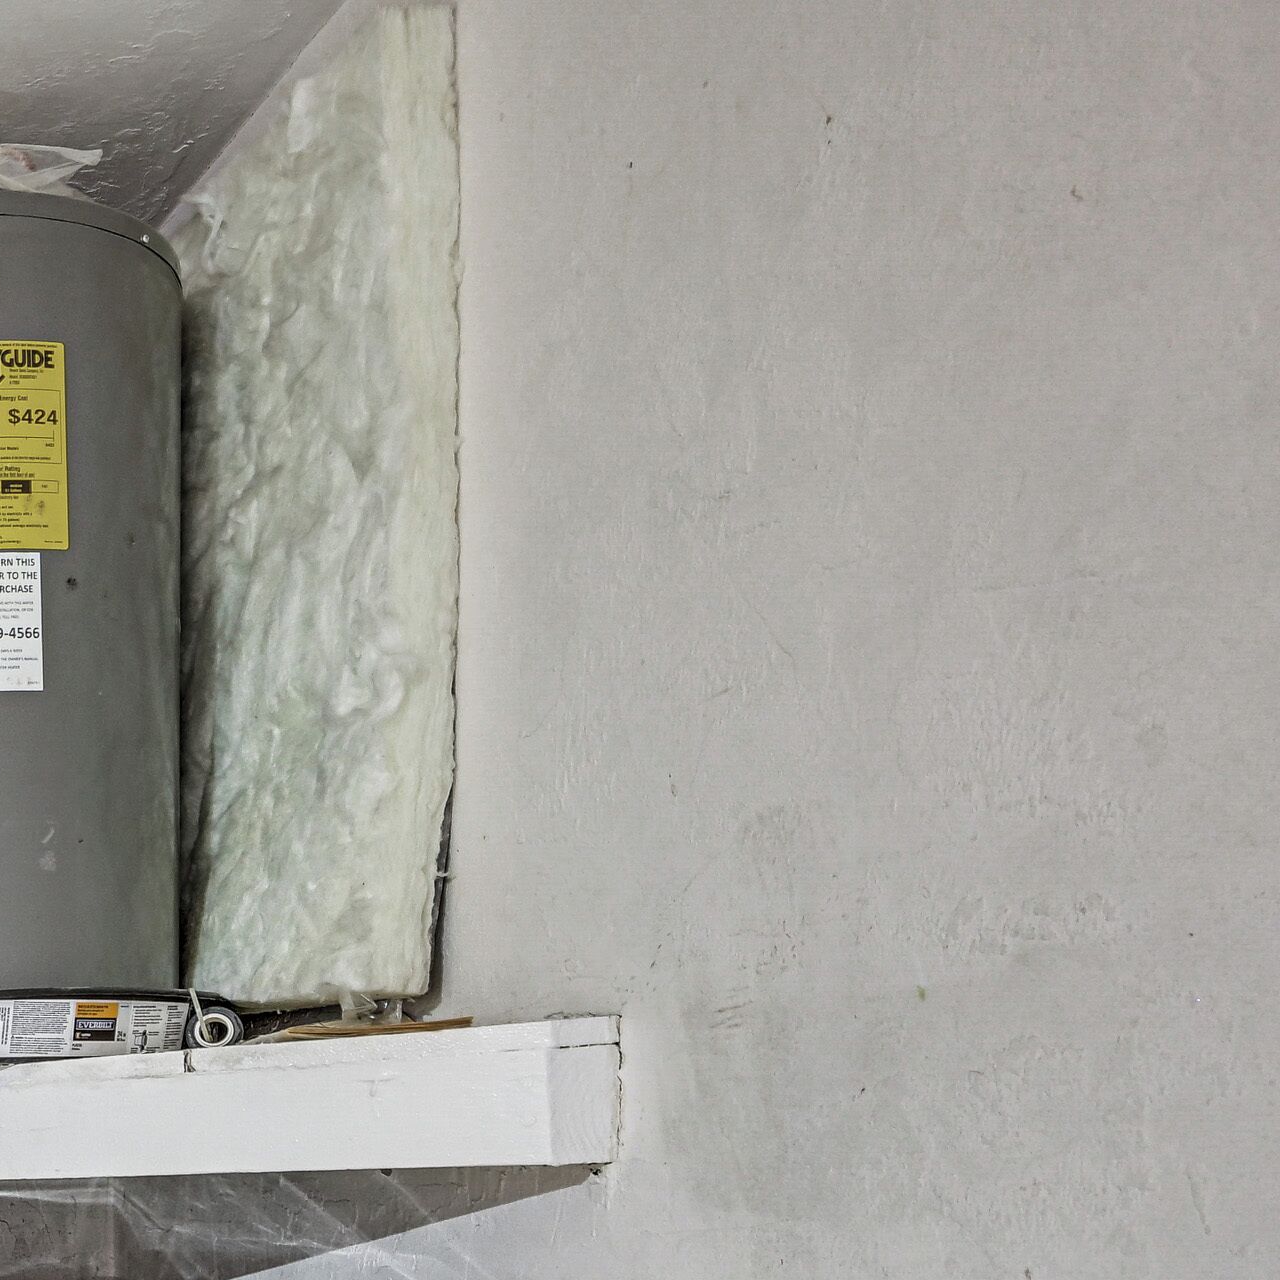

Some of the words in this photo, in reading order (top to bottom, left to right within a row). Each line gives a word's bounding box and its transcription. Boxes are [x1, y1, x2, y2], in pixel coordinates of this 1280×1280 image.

[8, 408, 58, 426] $424
[16, 558, 35, 566] THIS
[7, 572, 19, 580] TO
[21, 571, 37, 579] THE
[78, 1021, 113, 1029] EVERBILT
